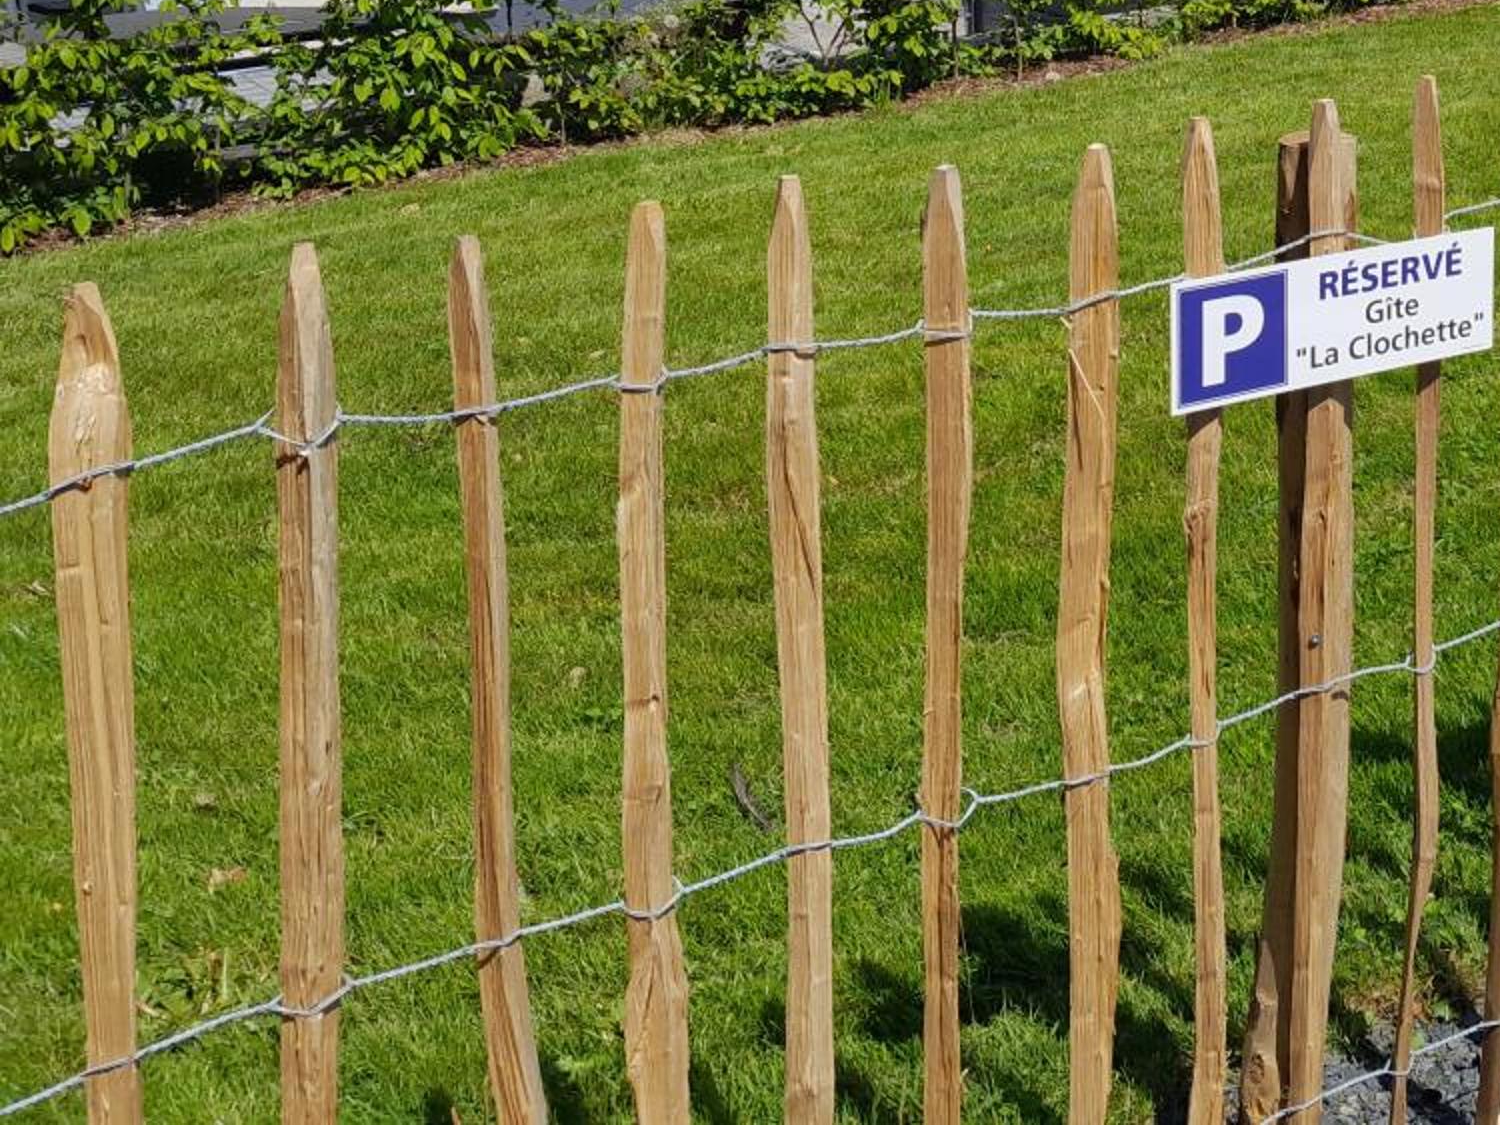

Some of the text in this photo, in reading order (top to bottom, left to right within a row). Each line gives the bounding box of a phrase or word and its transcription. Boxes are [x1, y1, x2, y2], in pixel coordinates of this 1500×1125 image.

[1319, 242, 1463, 301] RÉSERVÉ
[1365, 296, 1420, 324] Gîte
[1201, 294, 1266, 388] P
[1297, 312, 1485, 369] "La Clochette"
